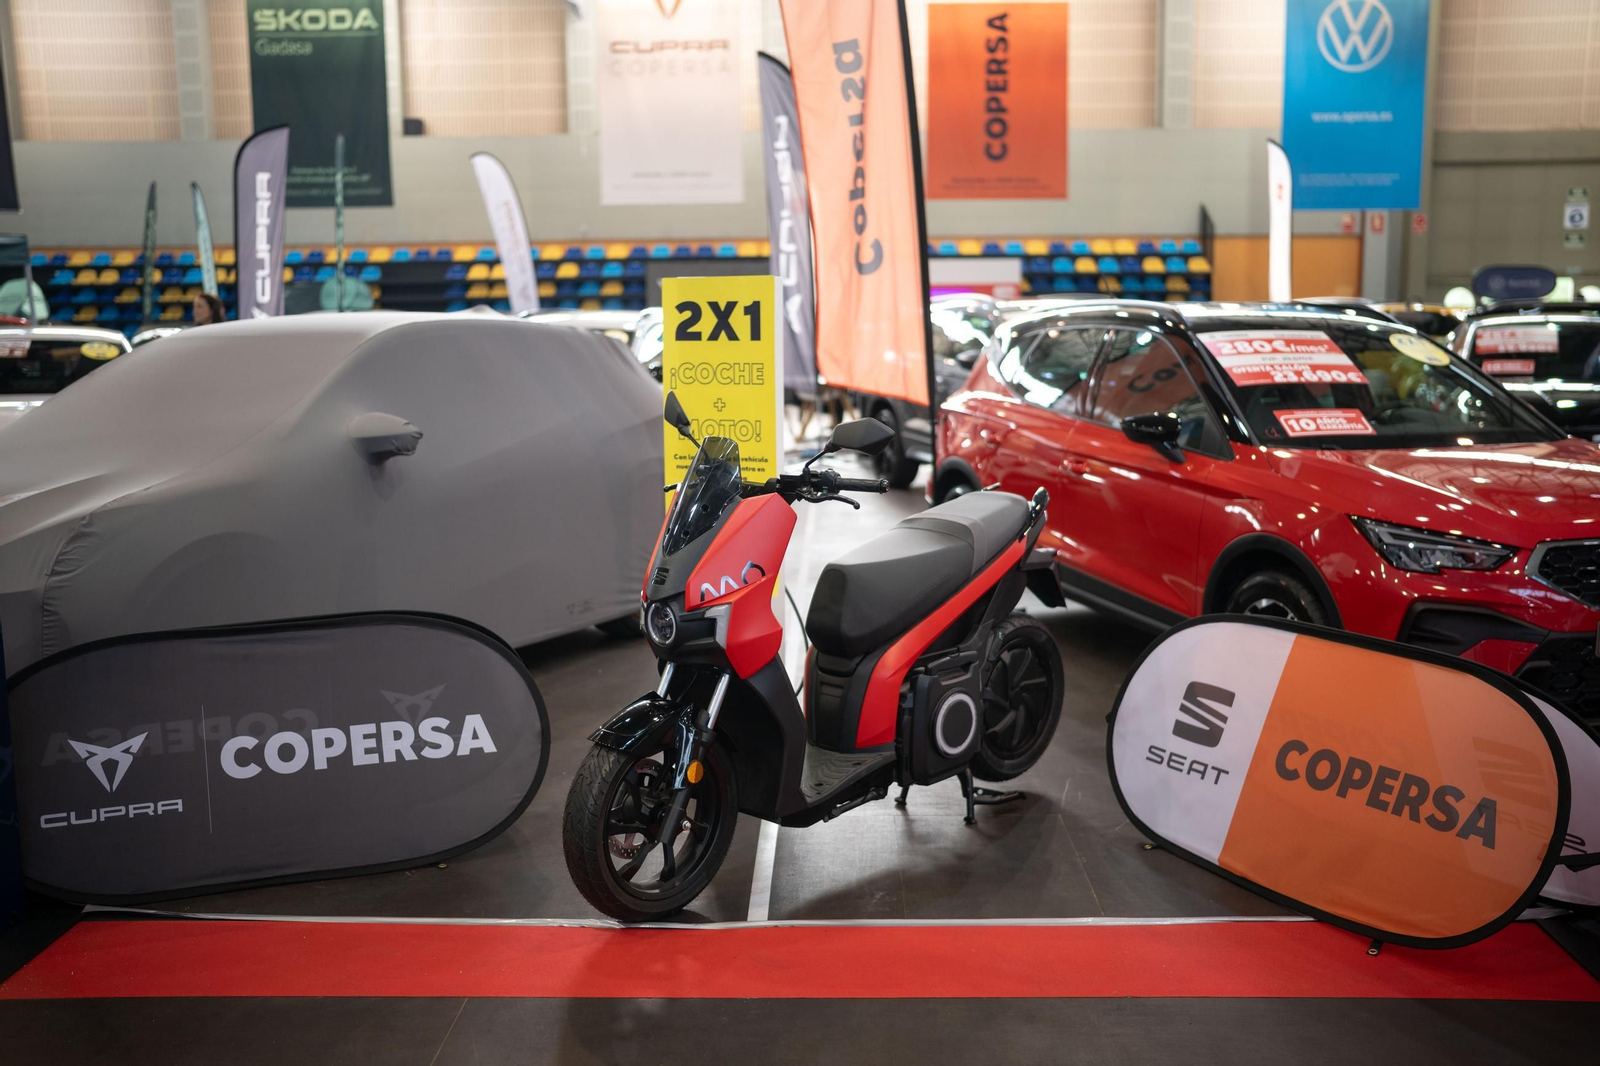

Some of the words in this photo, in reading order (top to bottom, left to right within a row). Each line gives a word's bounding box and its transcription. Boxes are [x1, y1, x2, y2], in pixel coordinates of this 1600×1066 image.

[609, 39, 730, 54] CUPRA
[984, 12, 1009, 162] COPERSA
[254, 172, 272, 305] CUPRA
[675, 301, 761, 342] 2X1
[670, 362, 764, 389] ¡COCHE
[1232, 365, 1272, 374] OFERTA
[678, 419, 761, 442] MOTO!
[1287, 418, 1317, 432] 10
[220, 713, 497, 780] COPERSA
[1146, 744, 1229, 786] SEAT
[1275, 739, 1497, 850] COPERSA
[40, 798, 183, 828] CUPRA
